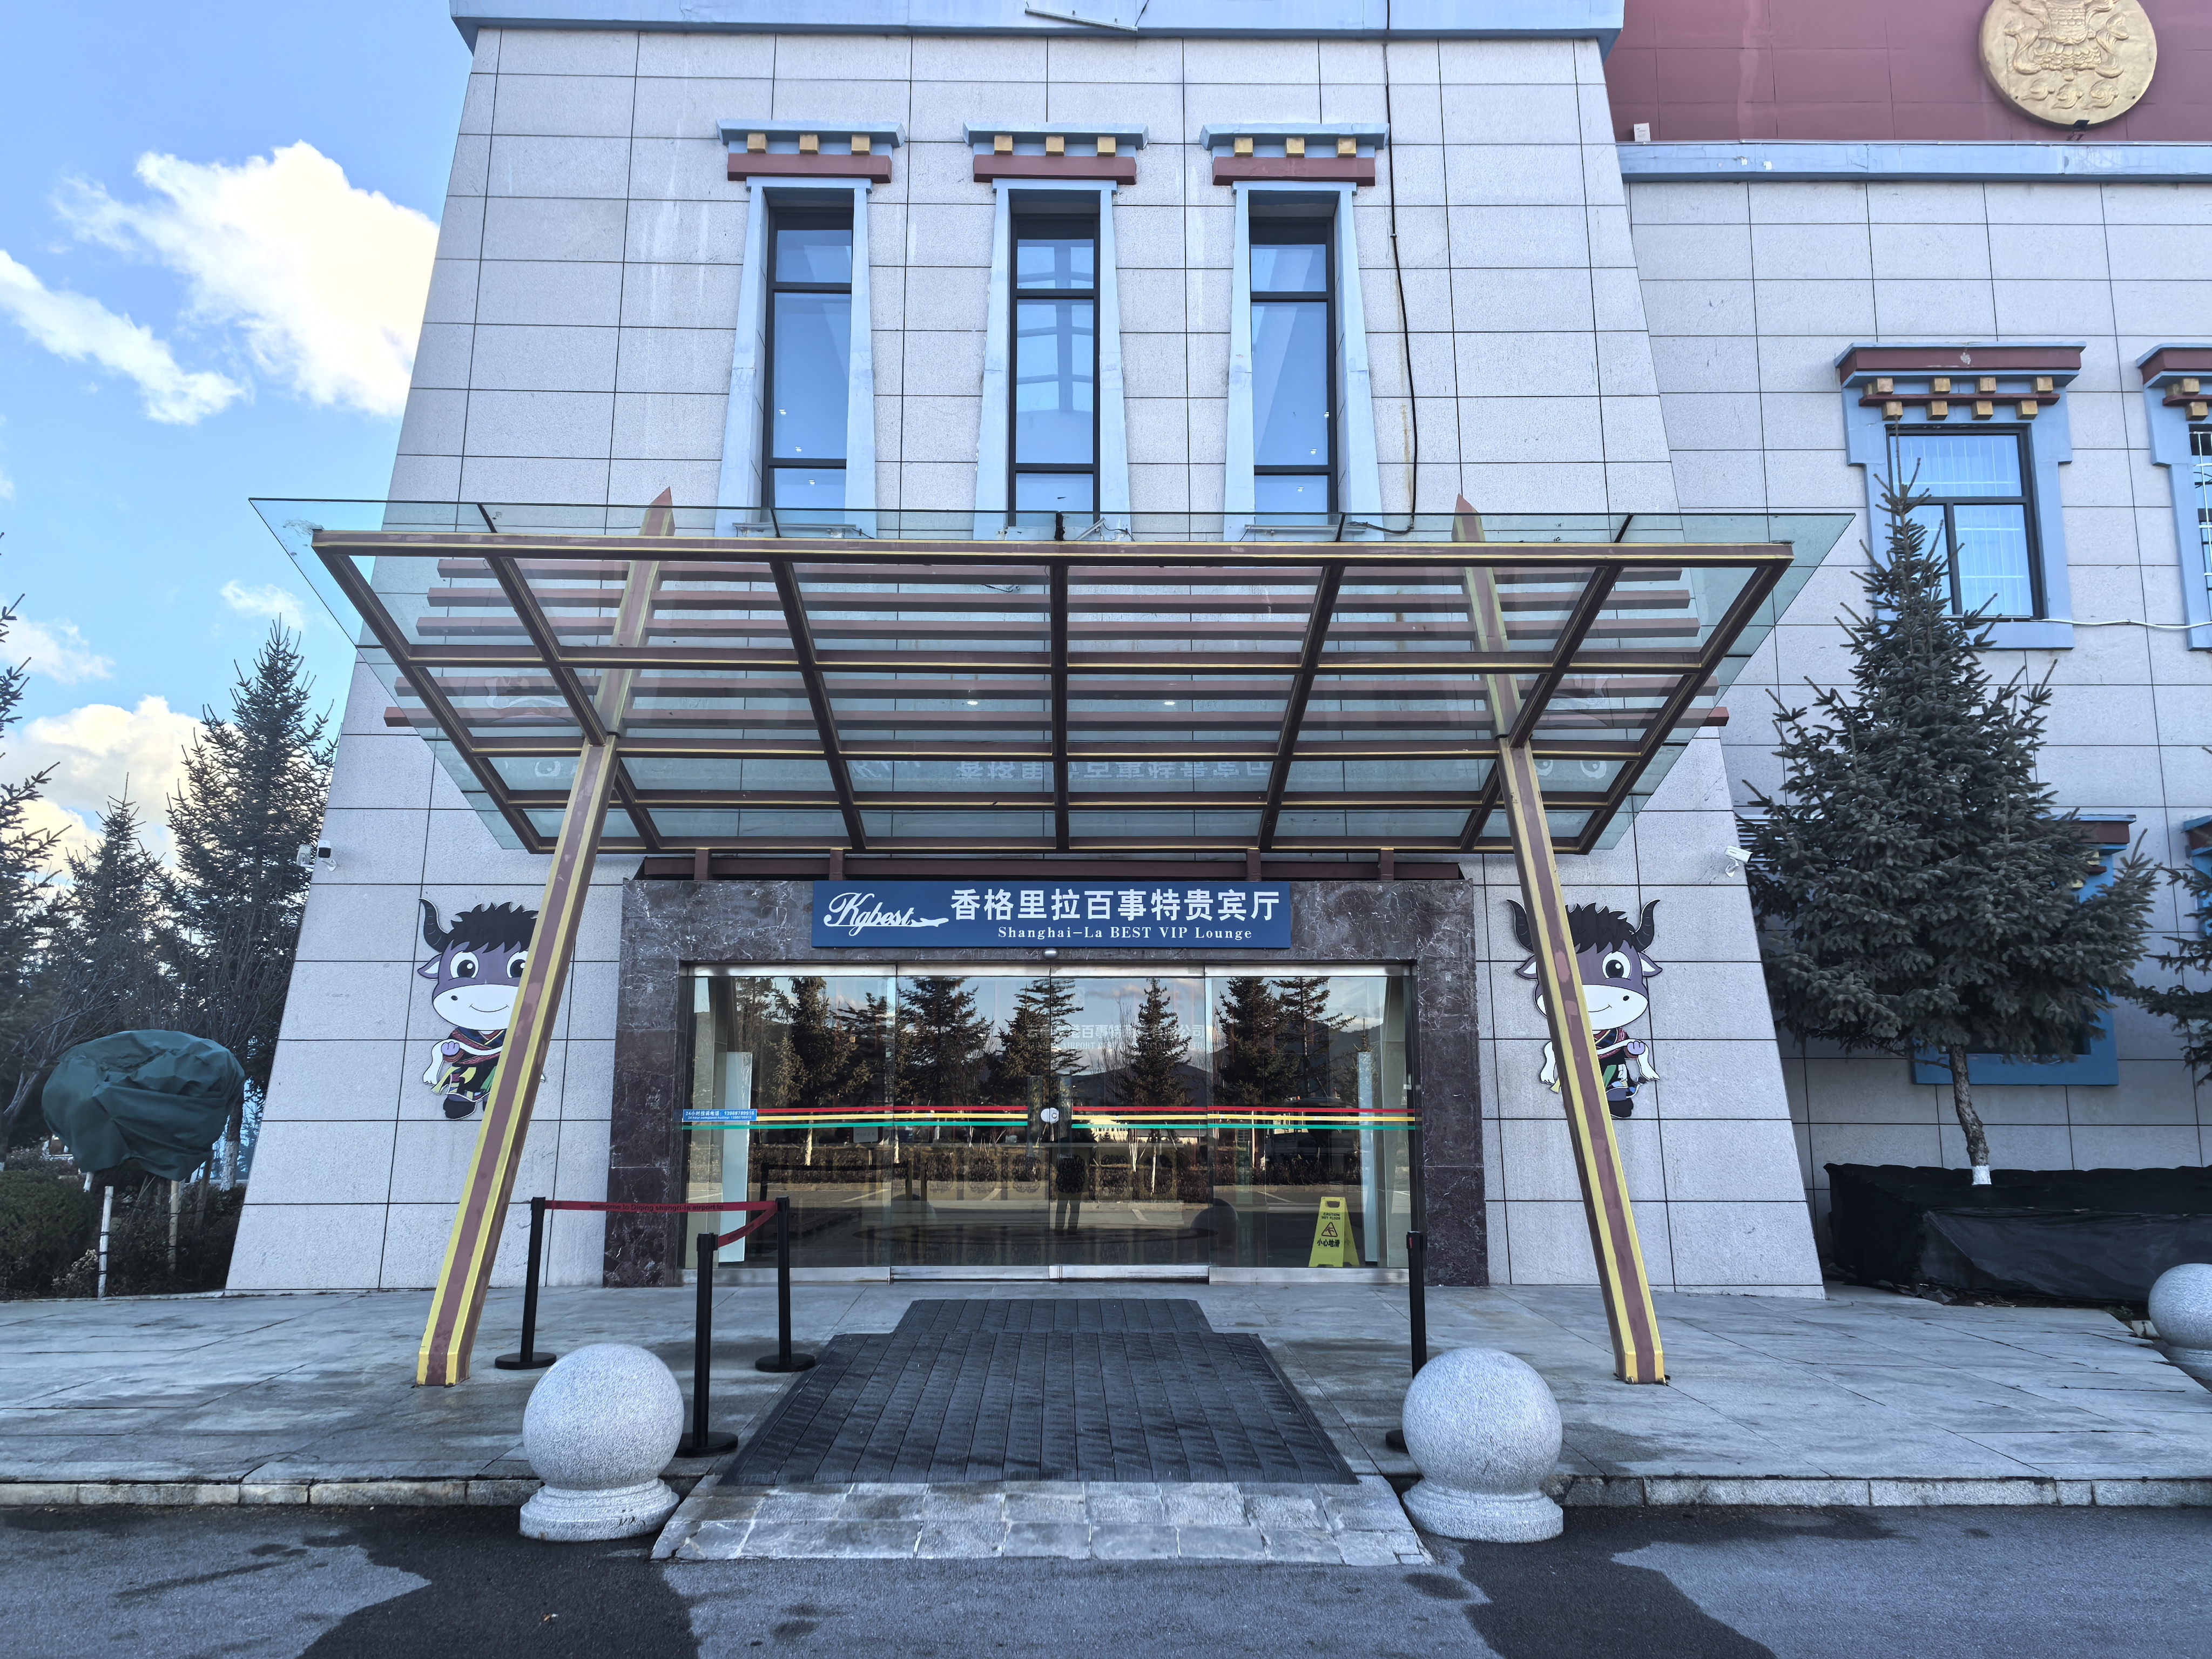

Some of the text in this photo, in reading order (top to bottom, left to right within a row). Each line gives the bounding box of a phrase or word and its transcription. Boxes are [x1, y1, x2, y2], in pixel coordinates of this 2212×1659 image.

[950, 889, 1280, 921] 香格里拉百事特贵宾厅
[998, 926, 1252, 940] Shanghai-La BEST VIP Lounge
[1317, 1238, 1340, 1247] 小心地滑
